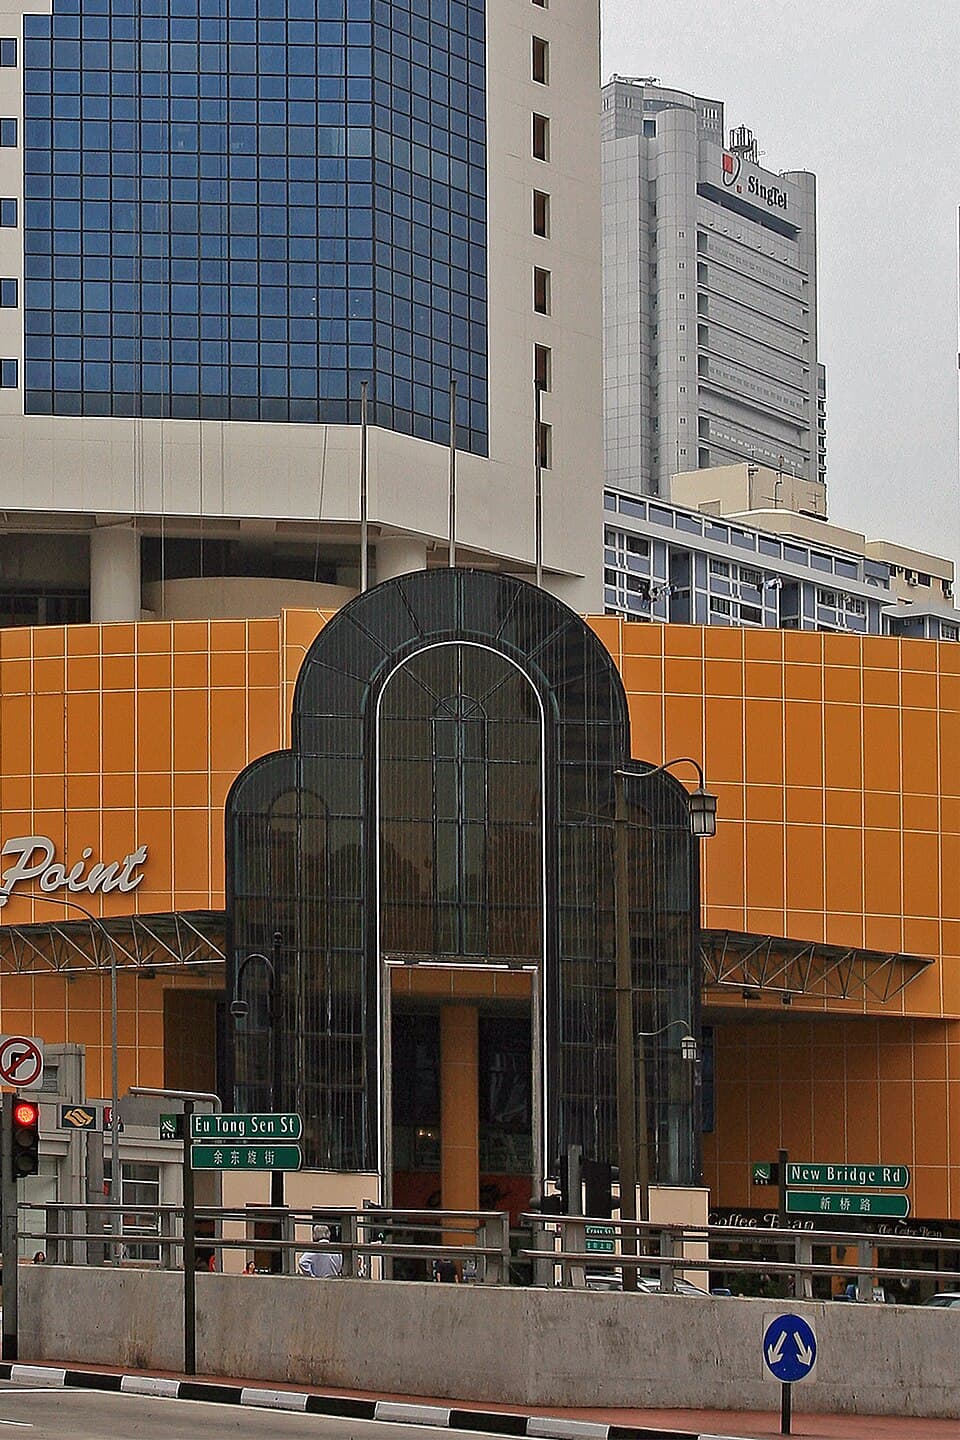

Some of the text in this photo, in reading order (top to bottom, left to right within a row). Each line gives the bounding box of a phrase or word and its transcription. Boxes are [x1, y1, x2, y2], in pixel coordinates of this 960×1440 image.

[748, 175, 787, 209] SingTel
[195, 1117, 294, 1136] Eu Tong Sen St
[791, 1166, 900, 1185] New Bridge Rd
[820, 1196, 871, 1212] 新桥路
[708, 1212, 758, 1228] Coffee
